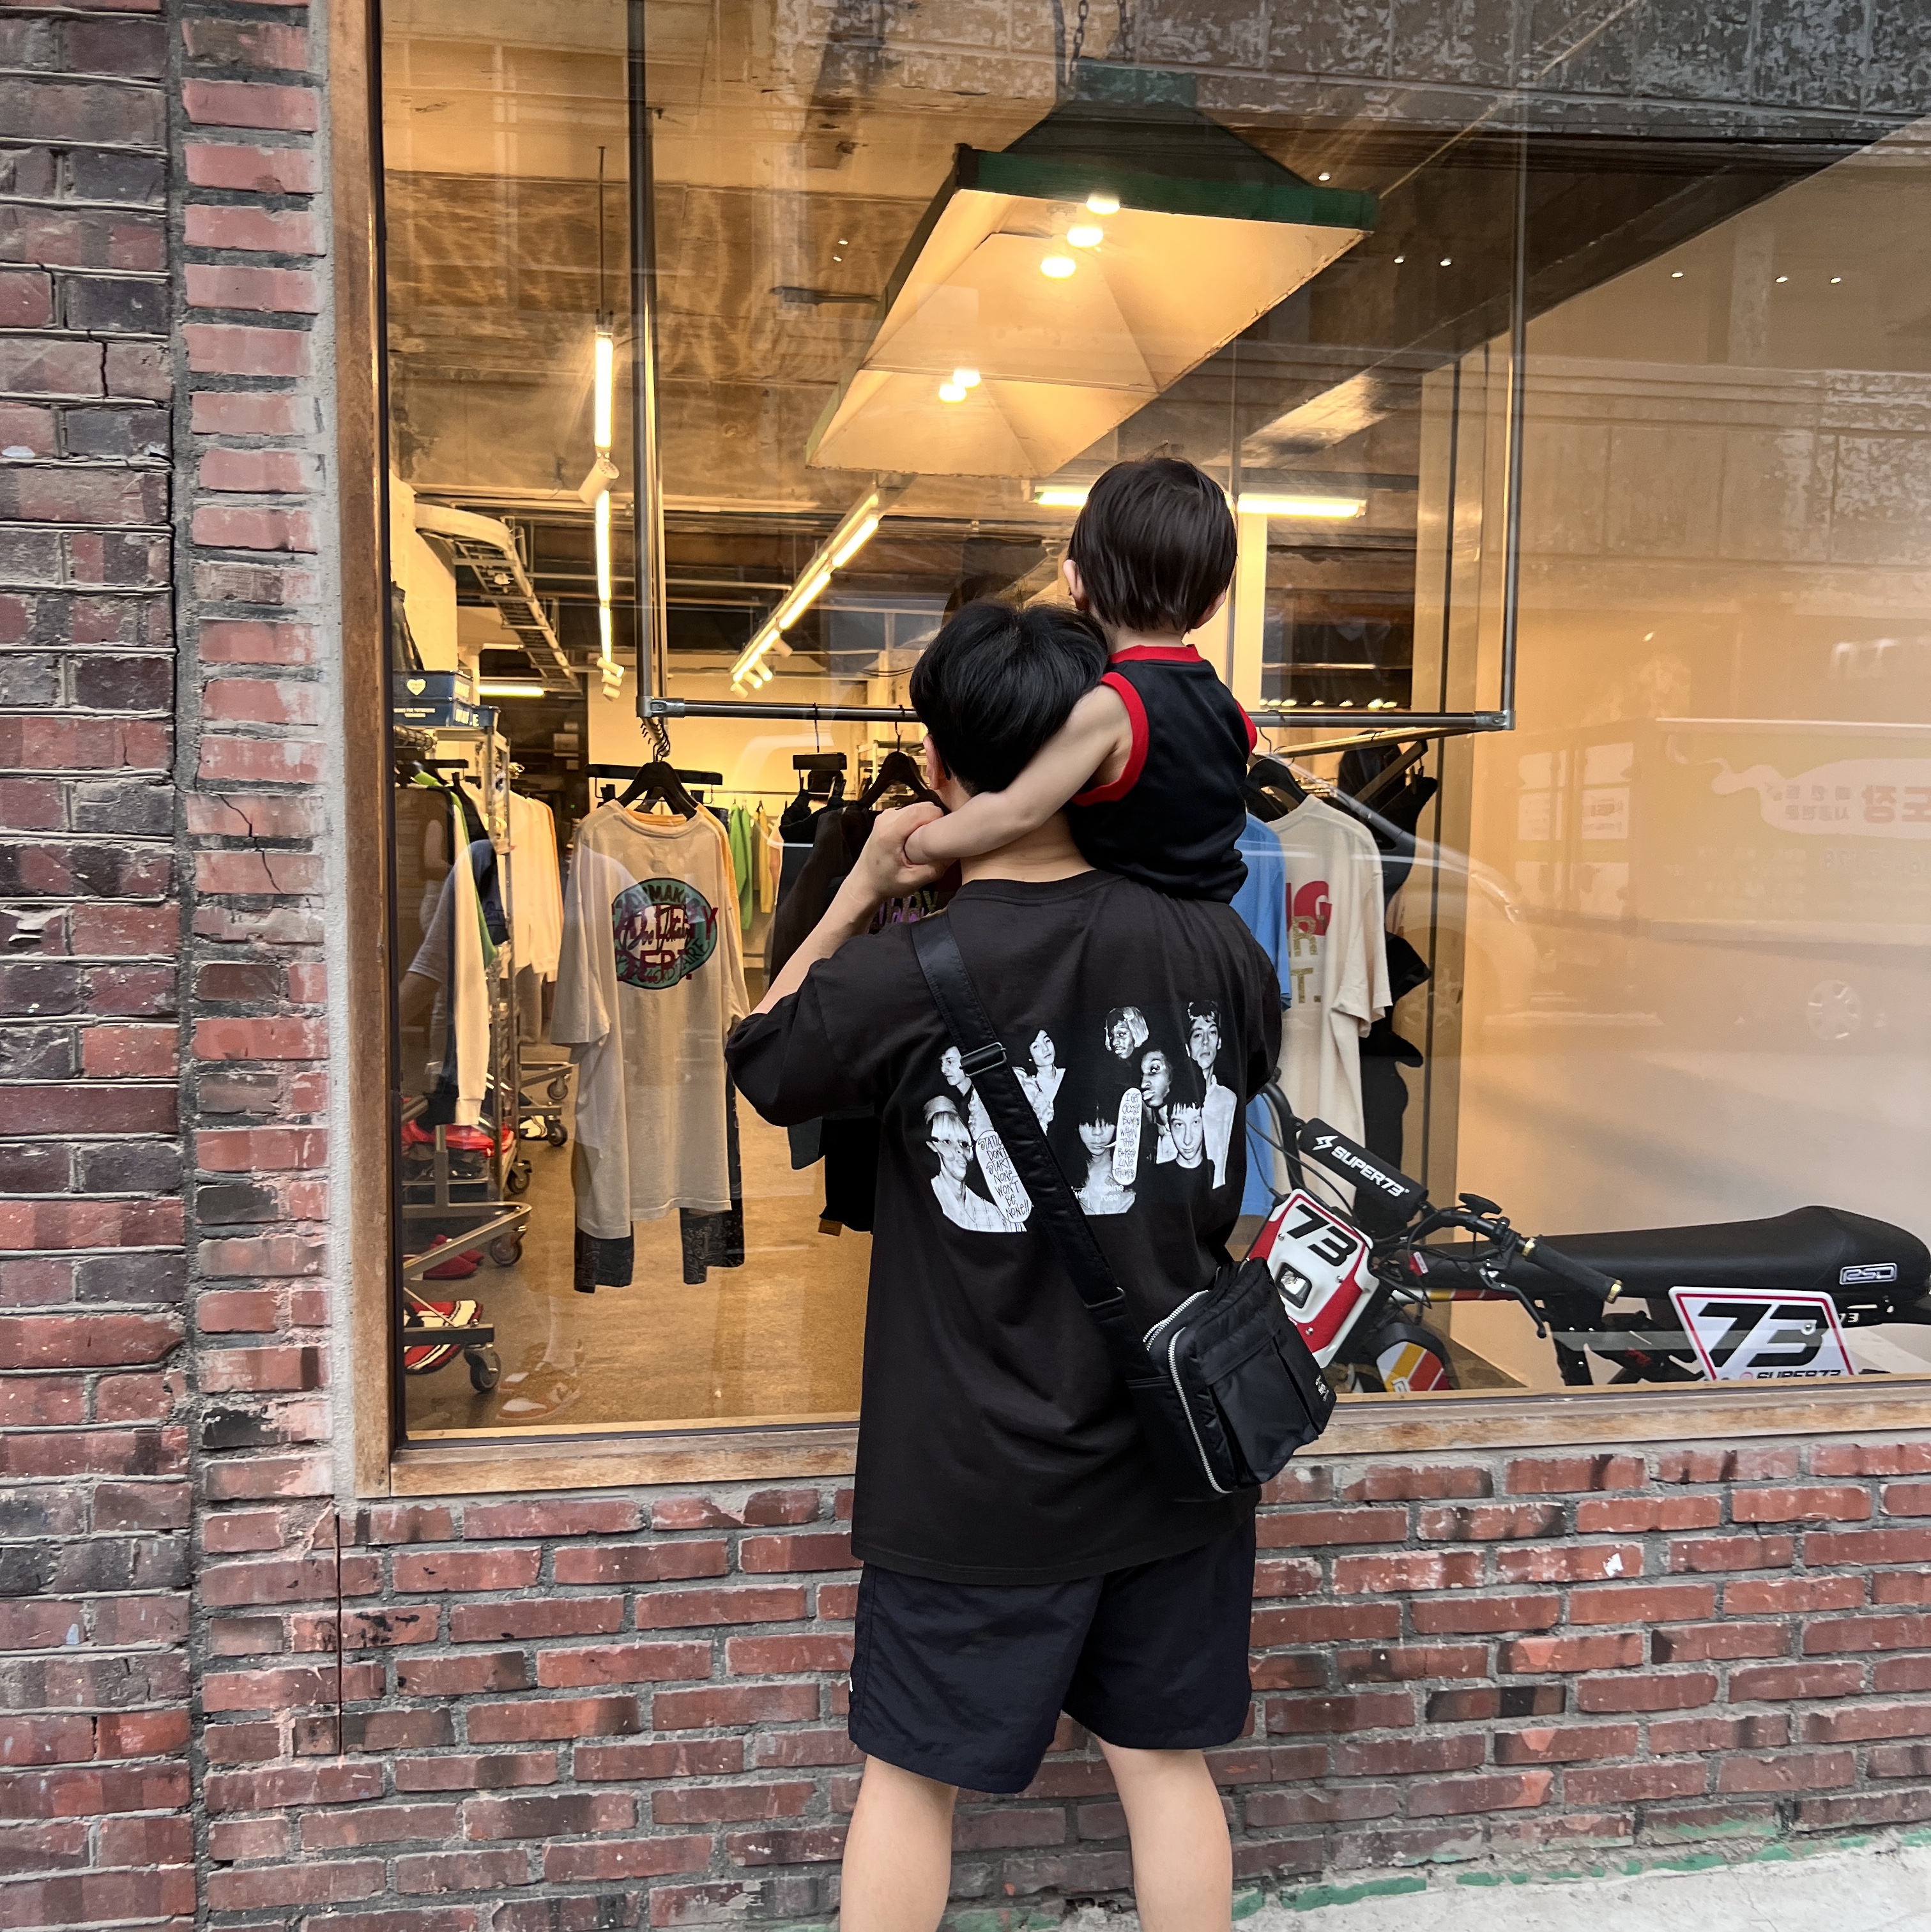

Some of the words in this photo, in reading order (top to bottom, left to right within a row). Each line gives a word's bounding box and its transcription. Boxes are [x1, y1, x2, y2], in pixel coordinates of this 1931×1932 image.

[611, 903, 719, 941] ALLERY
[1331, 1145, 1406, 1197] SUPER73
[1286, 1203, 1358, 1267] 73
[1698, 1302, 1833, 1368] 73
